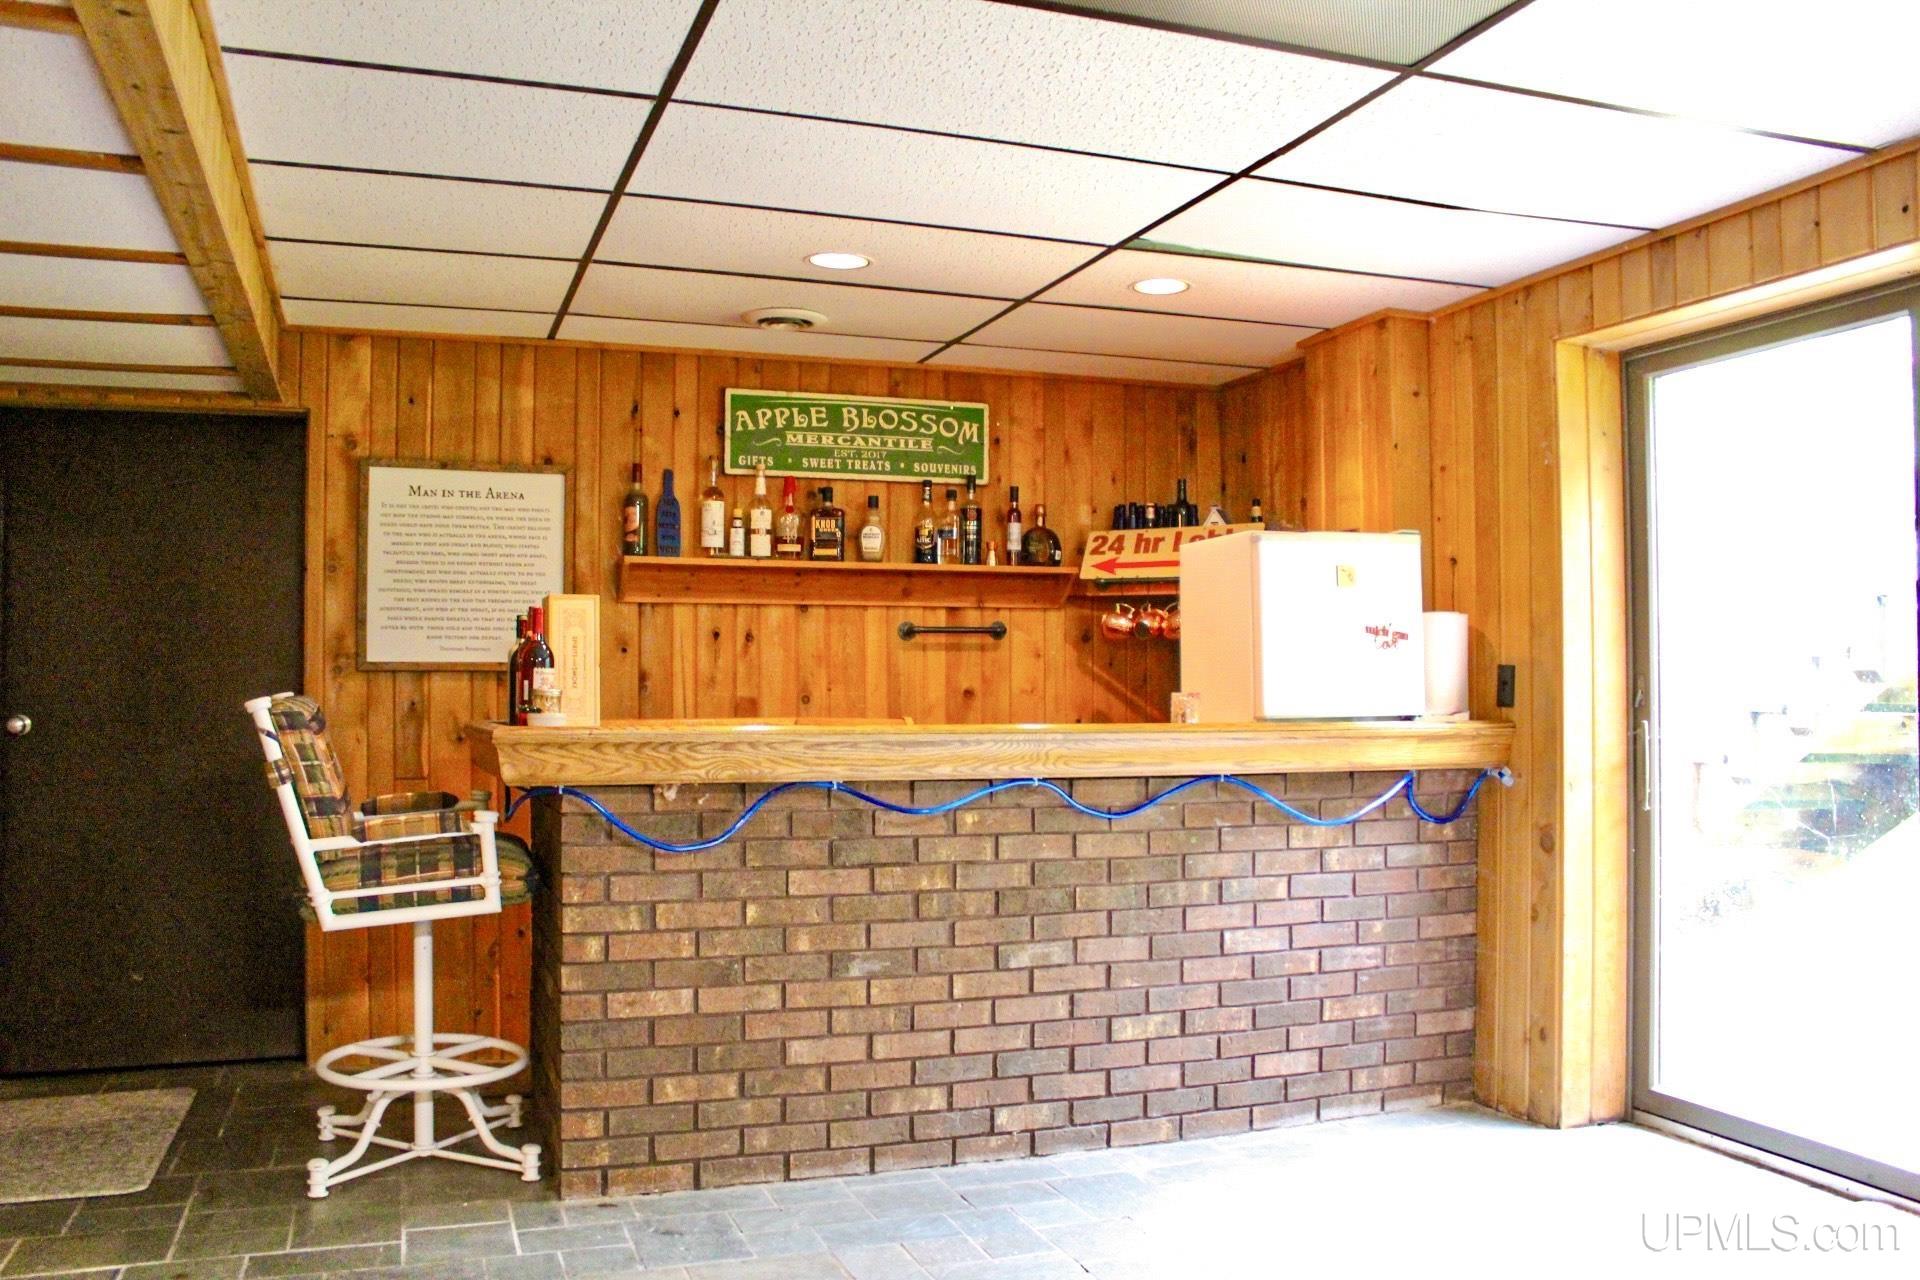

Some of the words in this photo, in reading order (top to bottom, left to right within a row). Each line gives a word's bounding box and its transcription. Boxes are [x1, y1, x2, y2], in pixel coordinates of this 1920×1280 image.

[735, 406, 829, 432] APPLE
[842, 407, 980, 445] BLOSSOM
[786, 433, 934, 450] MERCANTILE
[833, 449, 858, 458] EST.
[860, 450, 888, 459] 2017
[738, 455, 774, 467] GIFTS
[802, 458, 842, 470] SWEET
[844, 459, 892, 472] TREATS
[913, 462, 977, 475] SOUVENIRS
[1089, 534, 1126, 555] 24
[1133, 533, 1166, 554] hr
